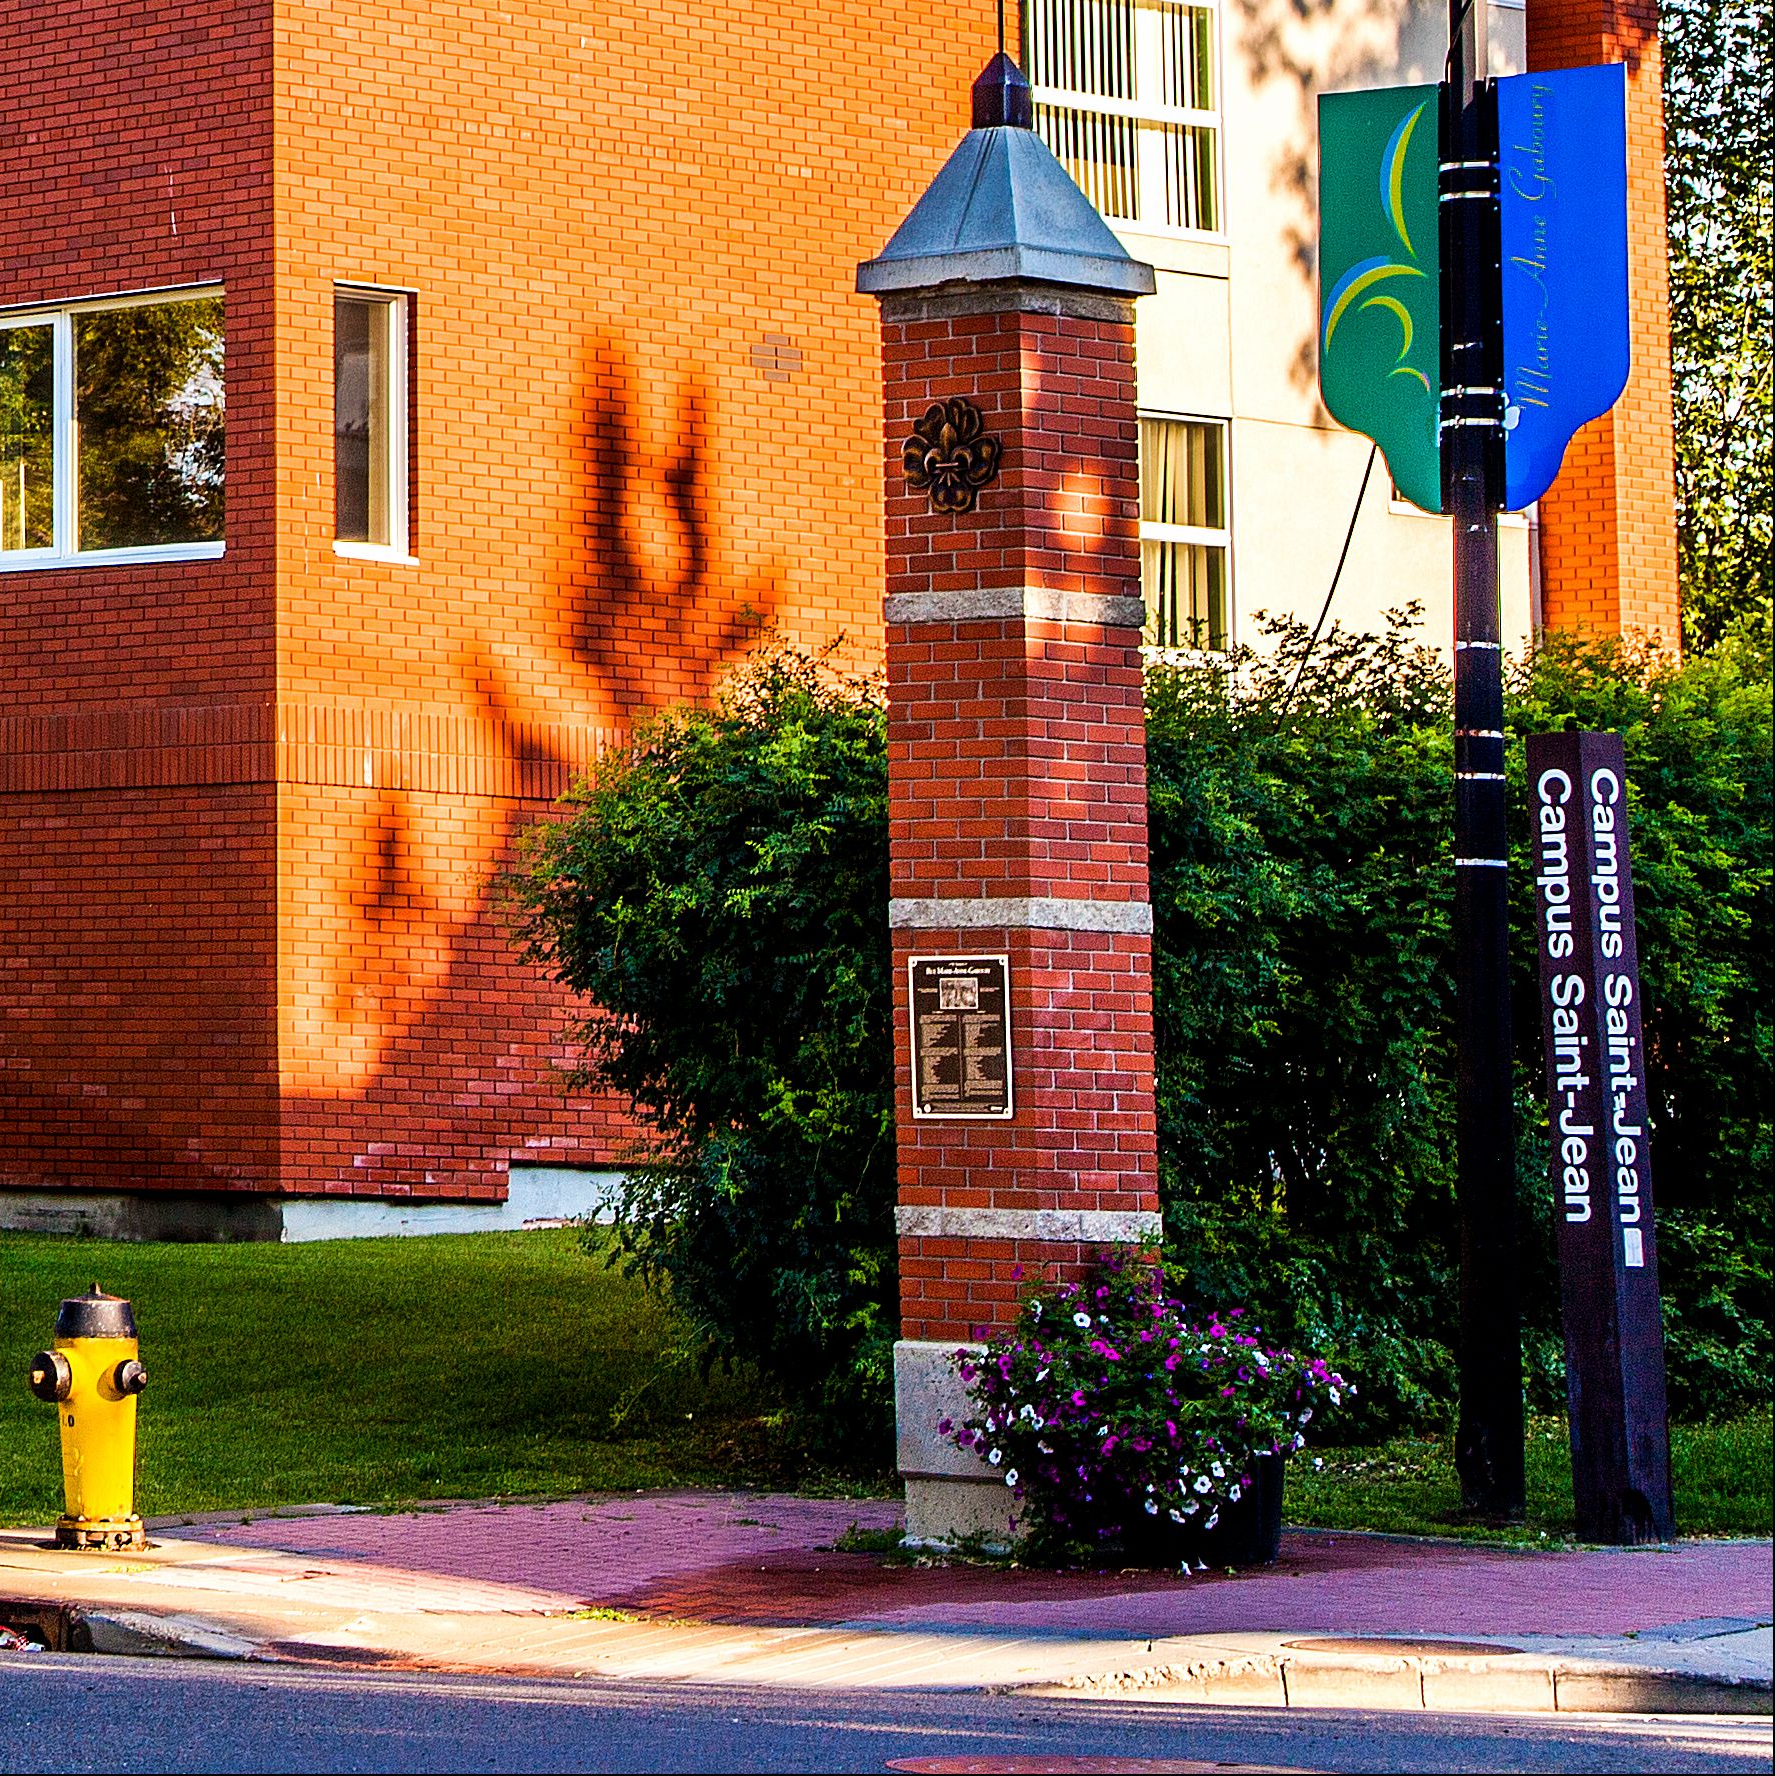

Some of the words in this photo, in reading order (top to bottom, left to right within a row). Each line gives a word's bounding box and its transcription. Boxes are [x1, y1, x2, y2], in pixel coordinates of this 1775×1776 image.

[1537, 768, 1574, 959] Campus
[1590, 767, 1623, 959] Campus
[1550, 973, 1594, 1222] Saint-Jean
[1603, 973, 1642, 1223] Saint-Jean
